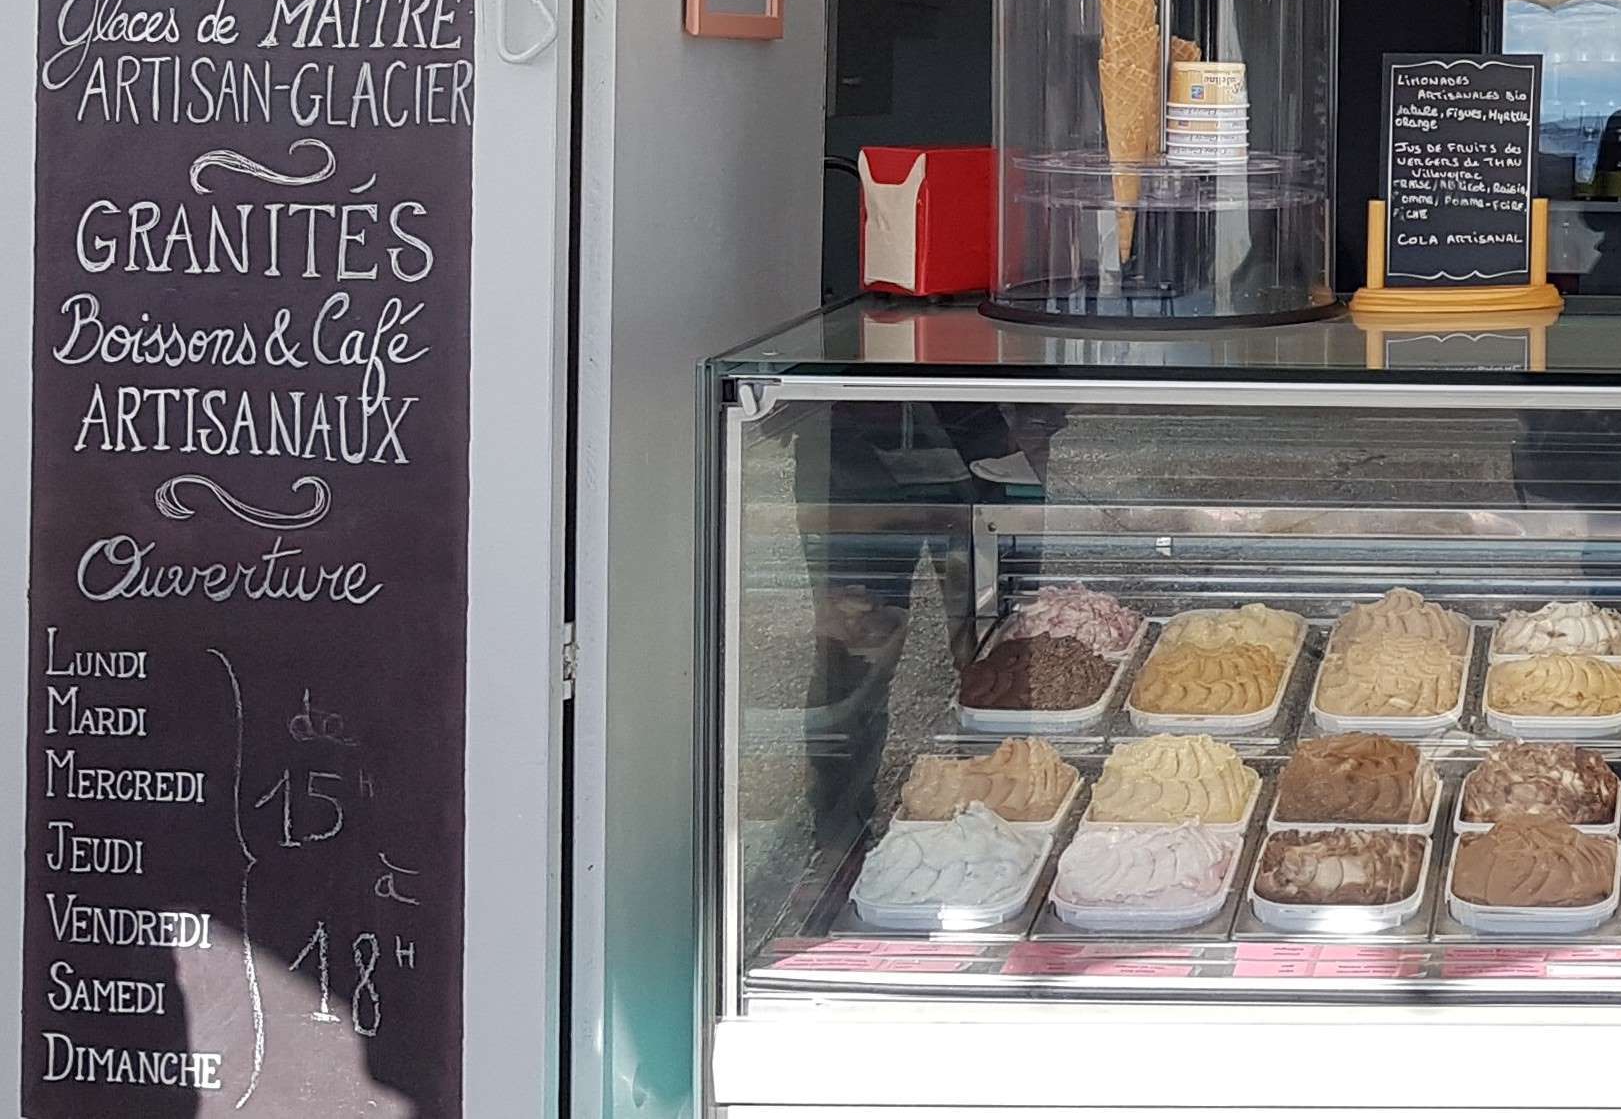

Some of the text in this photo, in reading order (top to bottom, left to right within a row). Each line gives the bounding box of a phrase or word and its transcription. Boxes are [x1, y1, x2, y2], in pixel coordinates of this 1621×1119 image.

[77, 56, 473, 128] ARTISAN-GLACIER
[1484, 158, 1522, 168] THAU
[1504, 143, 1522, 154] des
[75, 173, 434, 282] GRANITÉS
[1398, 233, 1438, 246] COLA
[53, 292, 429, 414] Boissons & Café
[74, 383, 419, 464] ARTISANAUX
[77, 535, 384, 605] Ouverture
[45, 627, 147, 679] LUNDI
[45, 686, 147, 737] MARDI
[45, 750, 206, 804] MERCREDI
[46, 822, 143, 874] JEUDI
[47, 894, 212, 949] VENDREDI
[48, 962, 166, 1015] SAMEDI
[42, 1033, 222, 1091] DIMANCHE
